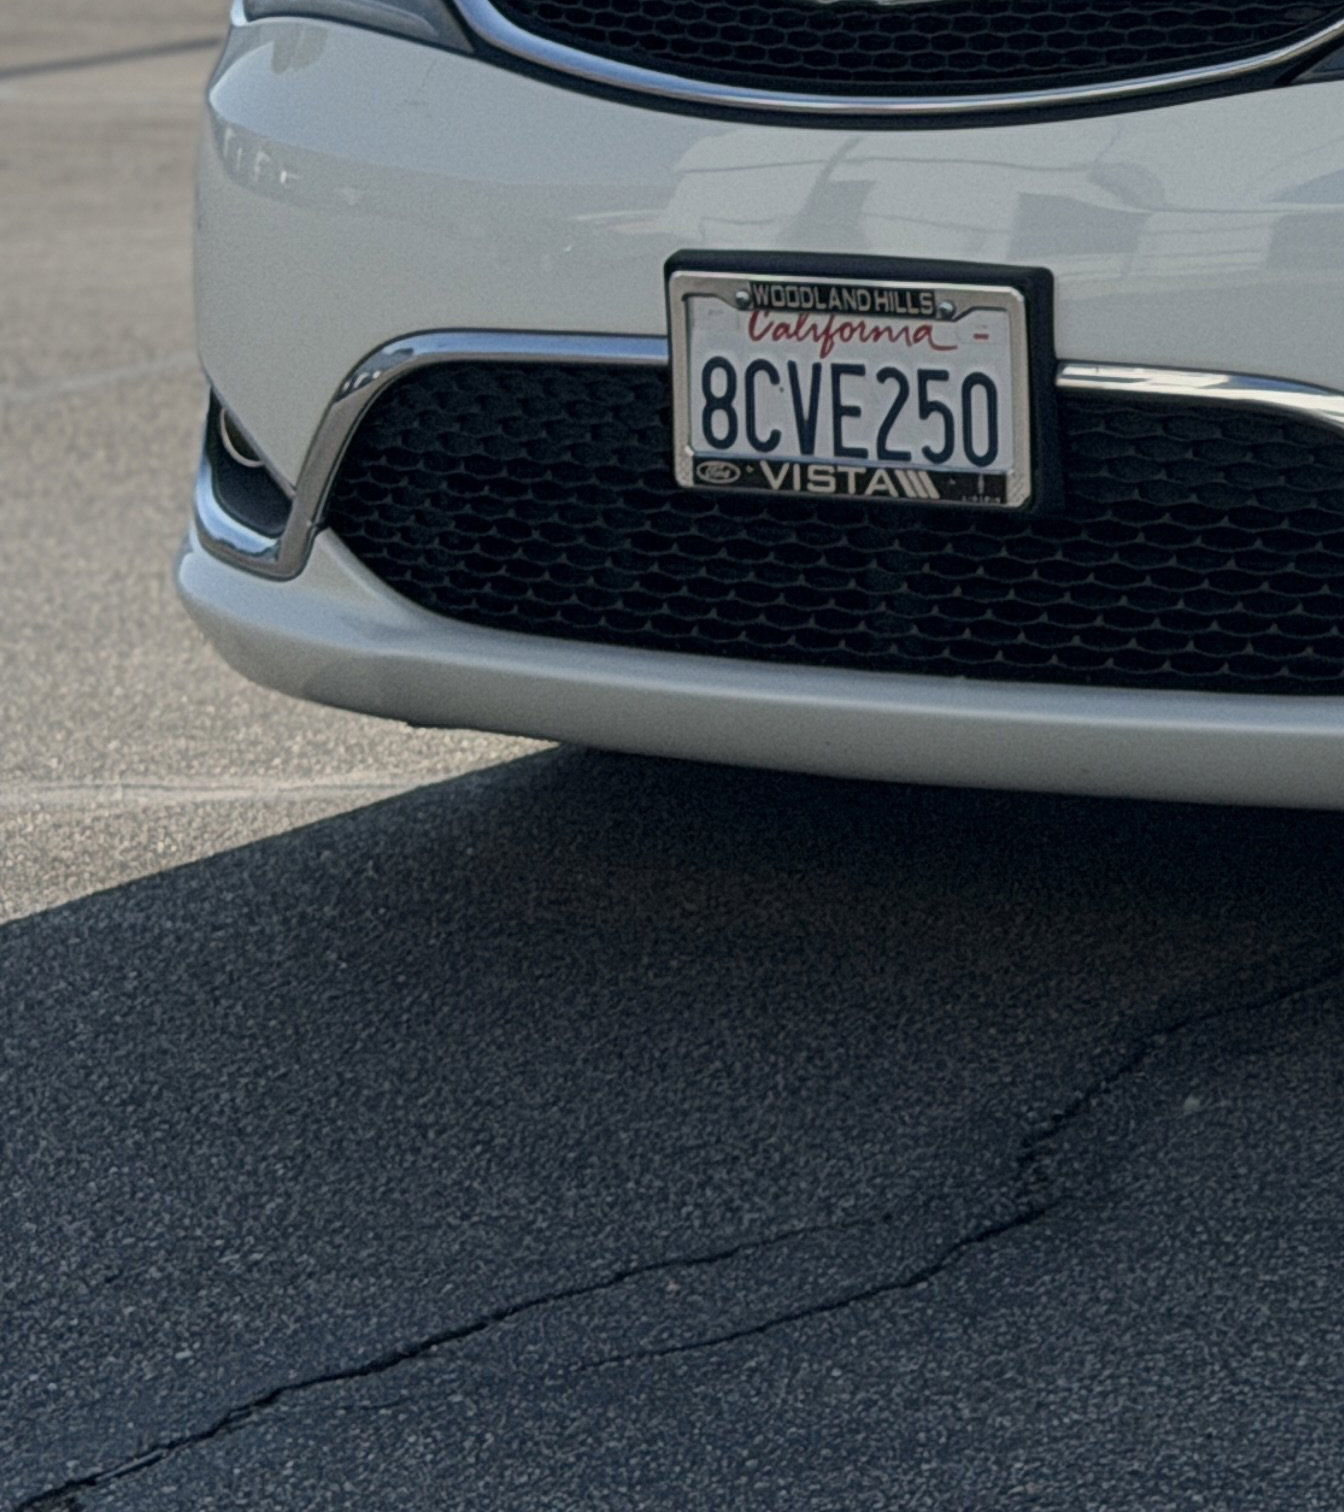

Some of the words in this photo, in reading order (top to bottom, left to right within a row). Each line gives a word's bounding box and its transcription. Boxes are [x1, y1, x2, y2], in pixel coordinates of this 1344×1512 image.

[752, 284, 871, 312] WOODLAND
[873, 289, 934, 316] HILLS
[747, 310, 958, 359] California
[702, 356, 998, 467] 8CVE250
[759, 459, 899, 498] VISTA
